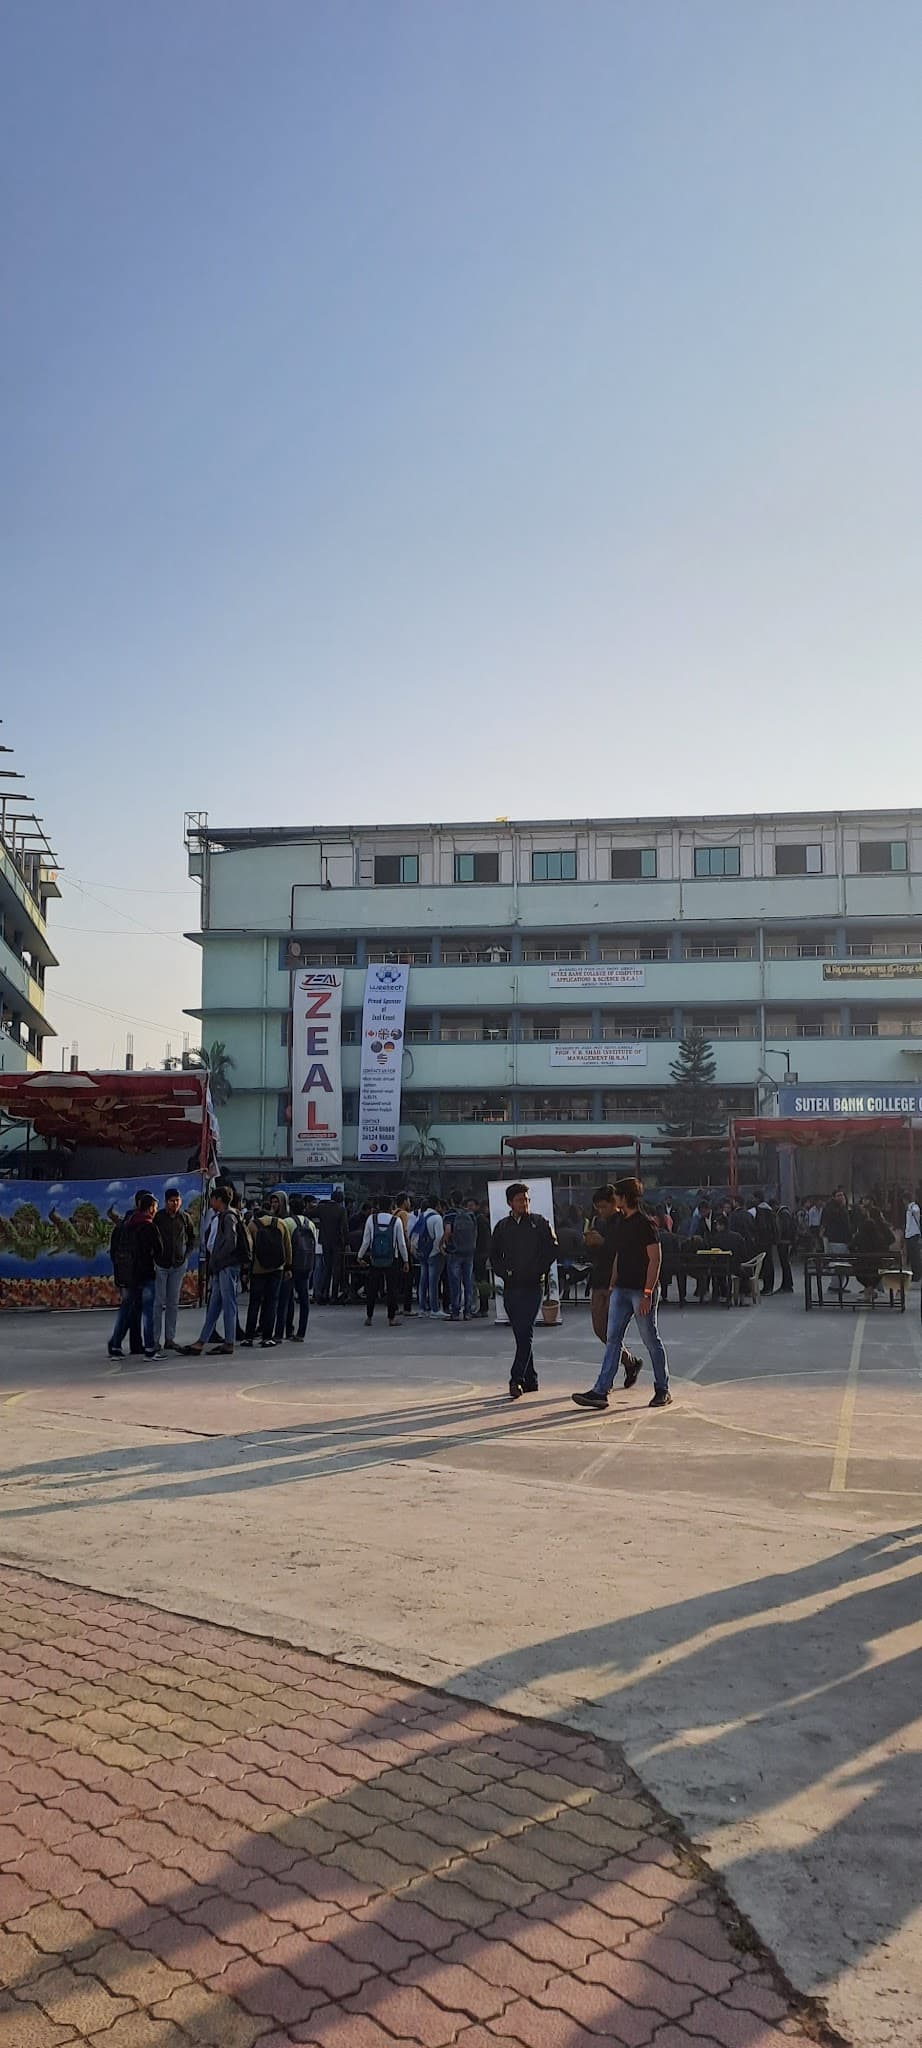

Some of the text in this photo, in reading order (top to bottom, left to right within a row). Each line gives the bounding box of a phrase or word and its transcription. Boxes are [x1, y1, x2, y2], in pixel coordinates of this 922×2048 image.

[303, 974, 338, 988] ZEAL
[301, 992, 334, 1131] ZEAL
[795, 1097, 830, 1112] SUTEX
[833, 1097, 864, 1112] BANK
[867, 1097, 916, 1112] COLLEGE
